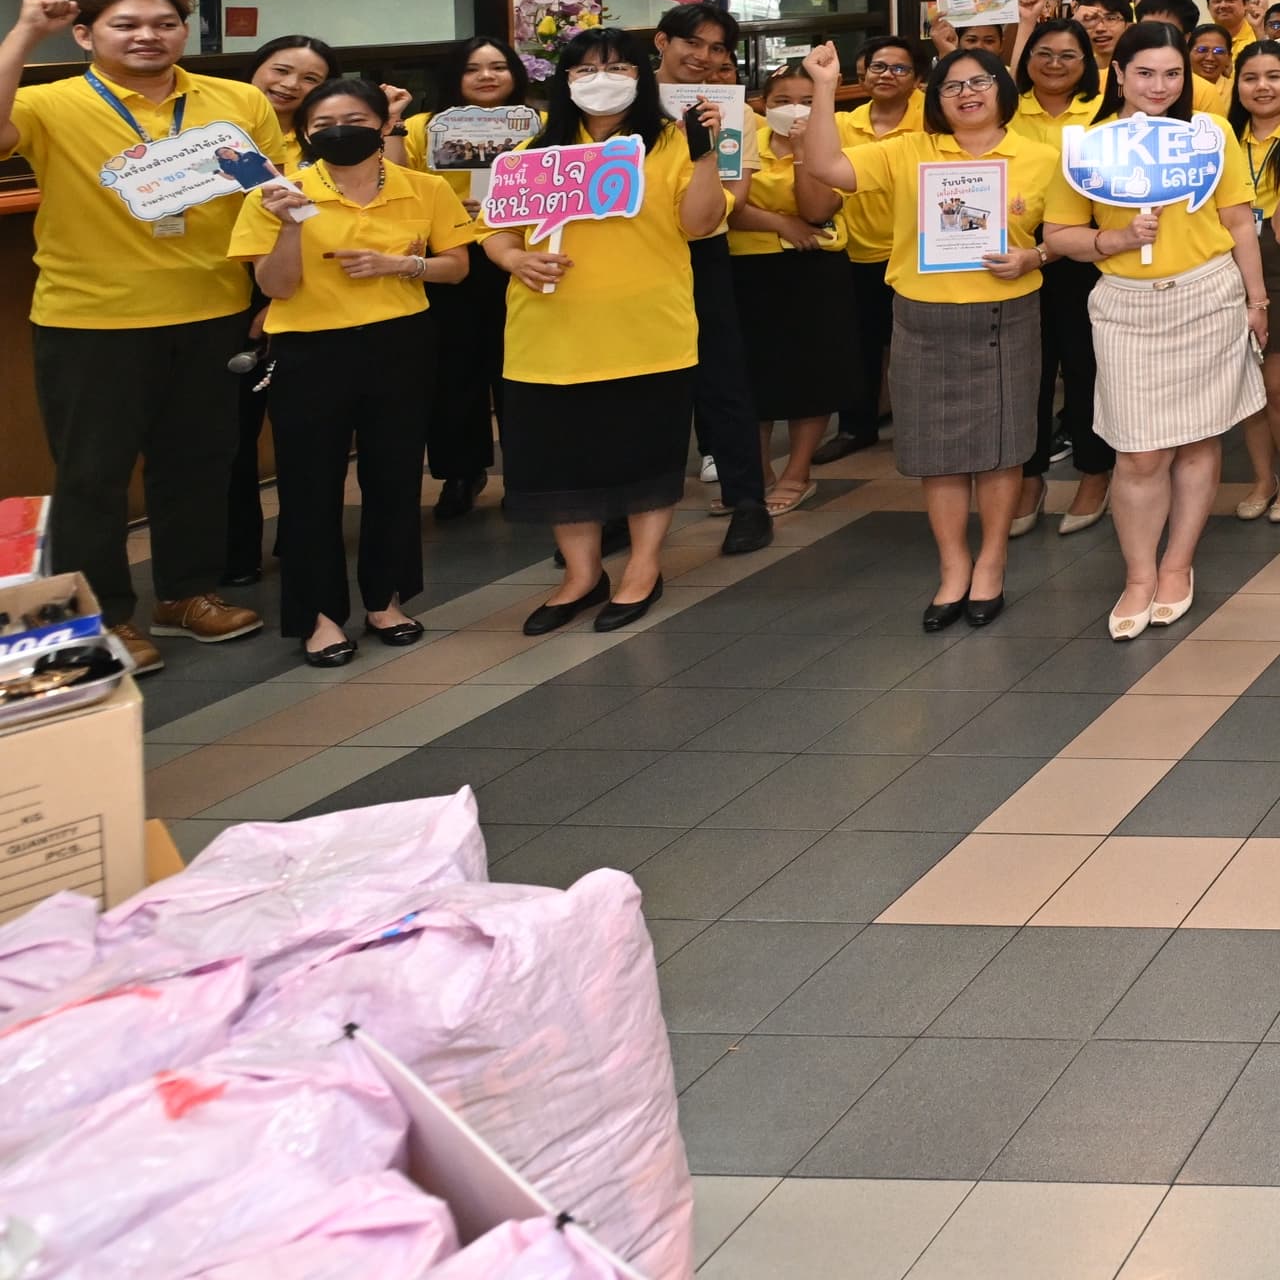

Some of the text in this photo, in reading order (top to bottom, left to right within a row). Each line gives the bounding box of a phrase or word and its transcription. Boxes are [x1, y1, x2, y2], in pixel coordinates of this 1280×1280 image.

[1069, 125, 1190, 168] LIKE
[541, 150, 586, 186] ใจ
[588, 138, 640, 216] ดี
[941, 176, 983, 187] รับบริจาค
[1161, 168, 1204, 188] เลย
[486, 187, 585, 219] หน้าตา
[6, 825, 79, 856] QUANTITY
